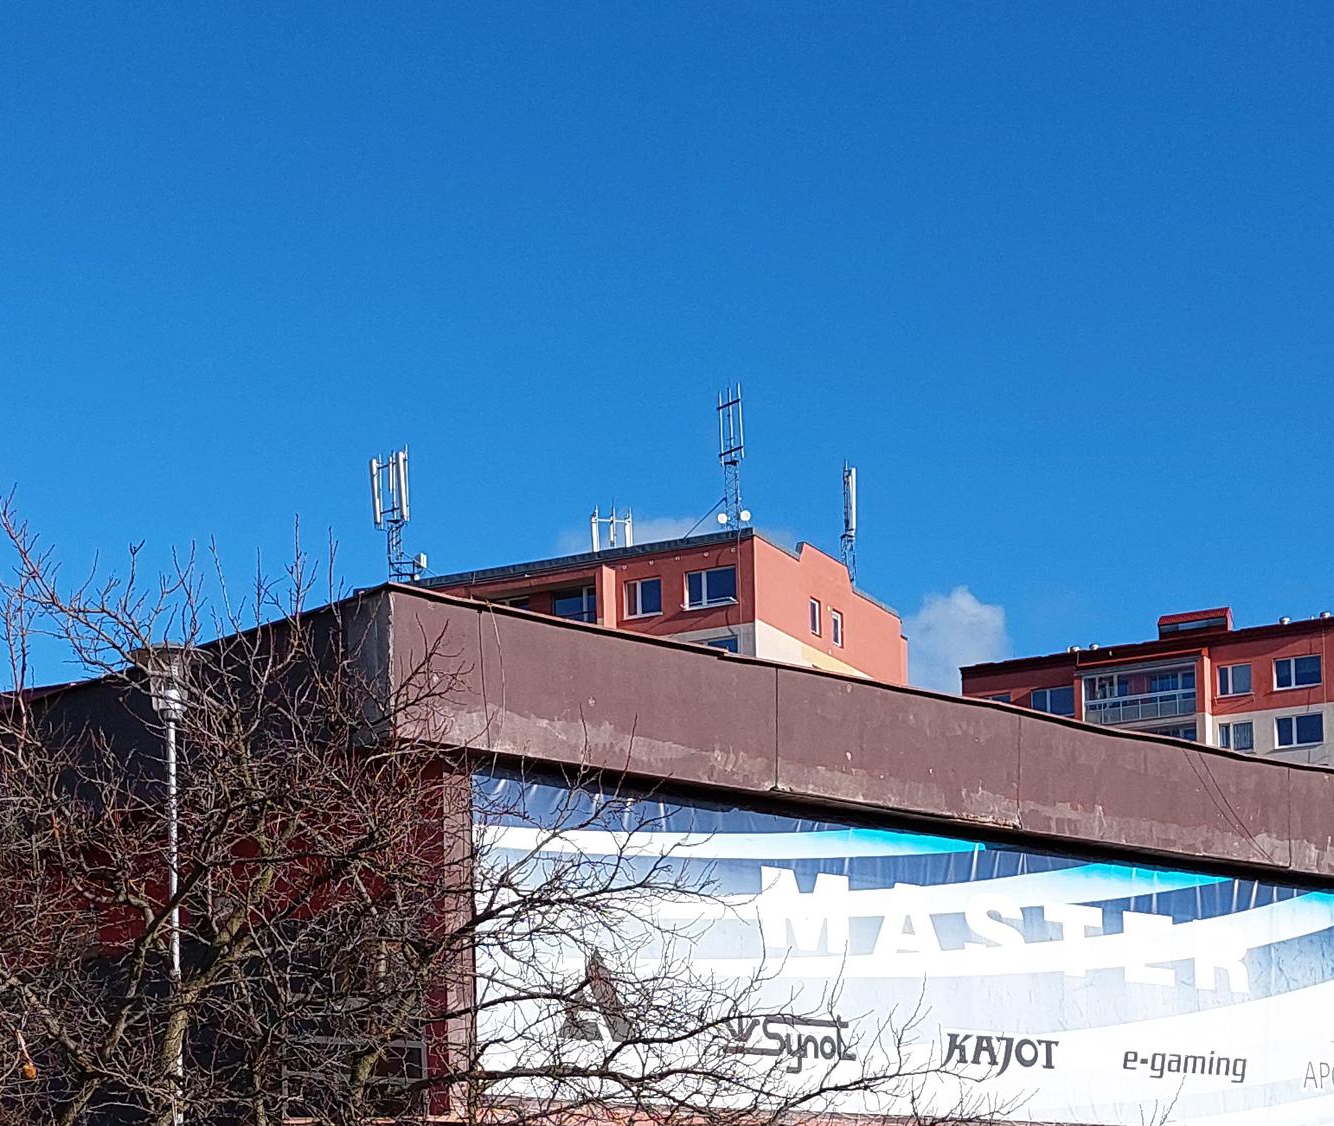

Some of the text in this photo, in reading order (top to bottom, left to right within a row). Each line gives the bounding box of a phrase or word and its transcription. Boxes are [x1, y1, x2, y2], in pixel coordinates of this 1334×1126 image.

[760, 865, 1250, 994] MASTER
[942, 1032, 1059, 1078] KAJOT
[1122, 1050, 1247, 1083] e-gaming
